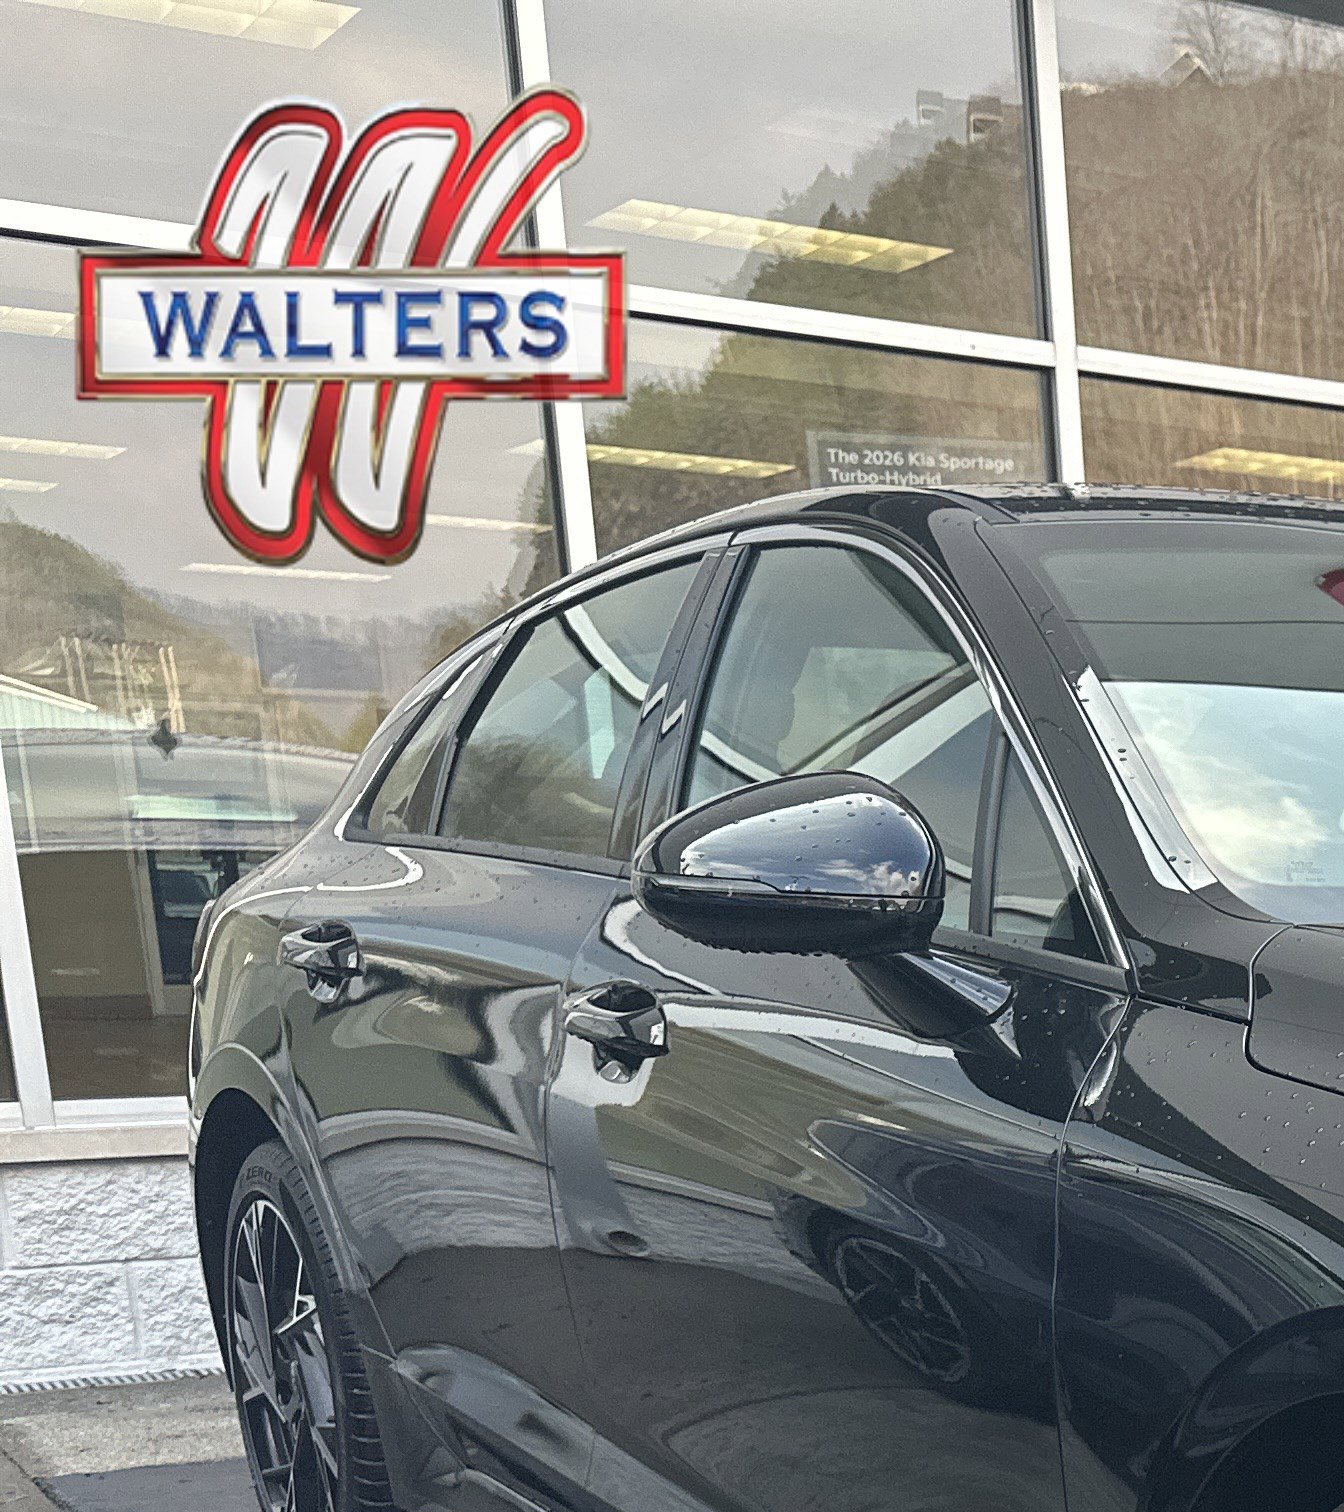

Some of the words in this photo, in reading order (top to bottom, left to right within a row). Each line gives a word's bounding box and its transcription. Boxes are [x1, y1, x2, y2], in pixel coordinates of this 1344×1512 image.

[827, 447, 859, 465] The
[862, 449, 905, 467] 2026
[908, 451, 935, 468] Kia
[939, 452, 1015, 475] Sportage
[827, 467, 943, 487] Turbo-Hybrid
